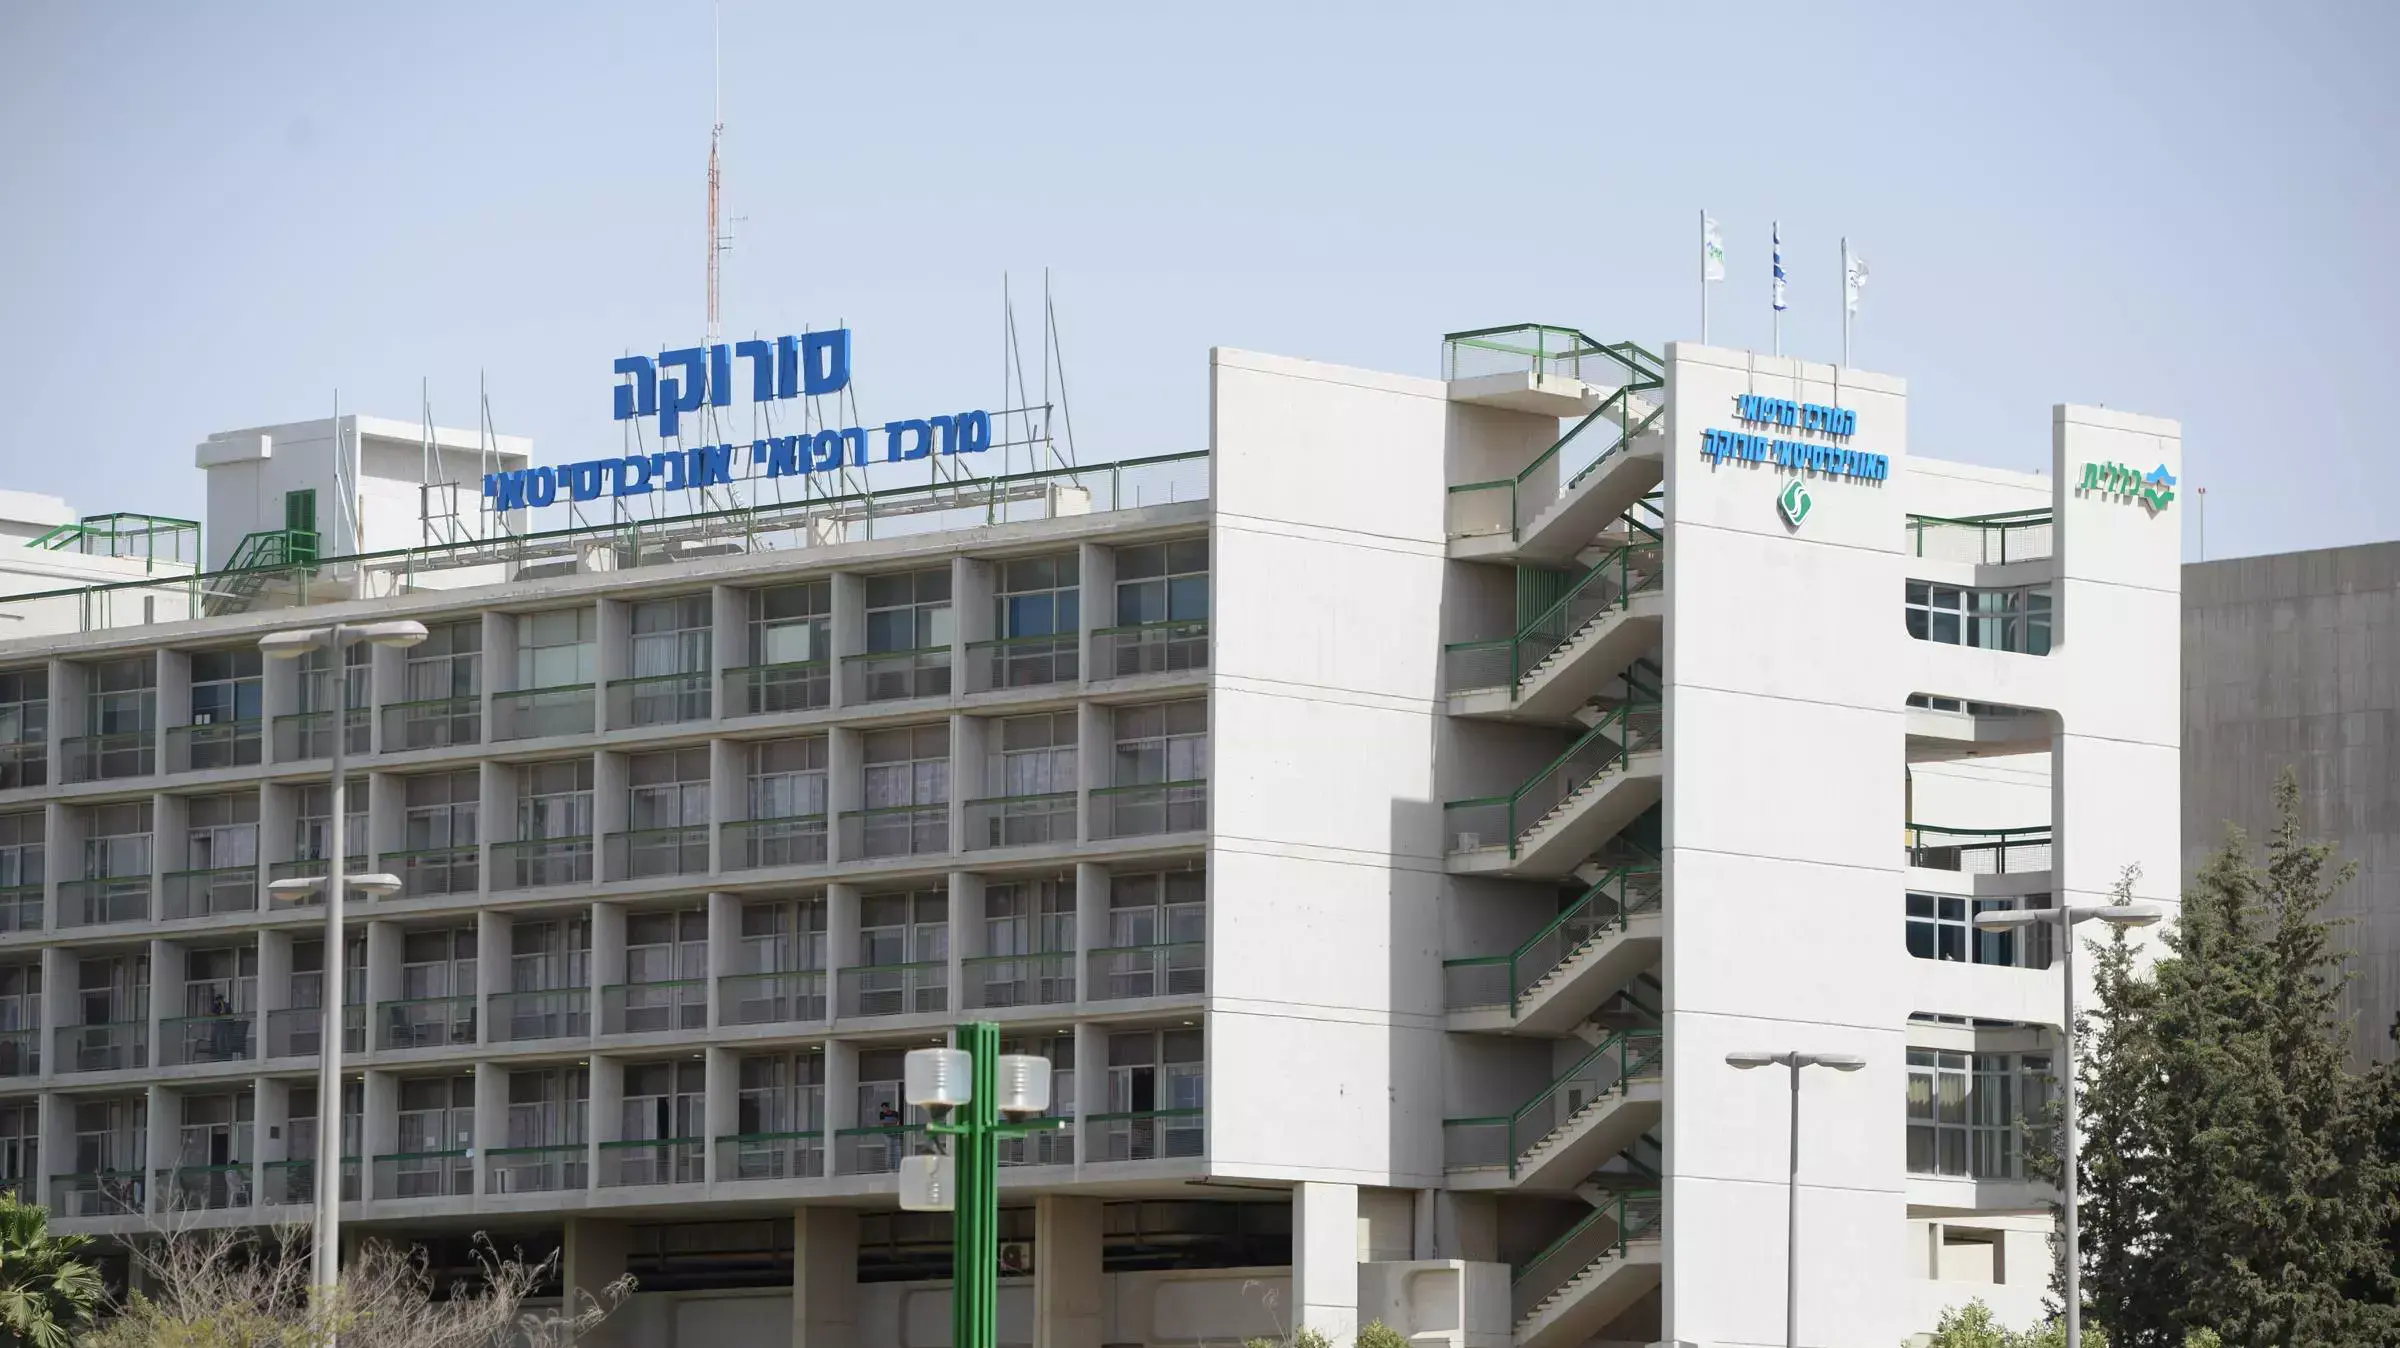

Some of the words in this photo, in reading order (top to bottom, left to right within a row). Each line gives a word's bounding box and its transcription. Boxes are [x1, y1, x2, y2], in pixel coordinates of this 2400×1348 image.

[614, 328, 851, 437] סורוקה
[1739, 393, 1798, 427] הרפואי
[1804, 402, 1857, 436] המרכז
[753, 427, 868, 478] רפואי
[885, 410, 991, 462] מרכז
[1703, 428, 1769, 465] סורוקה
[485, 444, 733, 511] אוניברסיטאי
[1774, 439, 1889, 480] האוניברסיטאי
[2081, 461, 2142, 496] כללית
